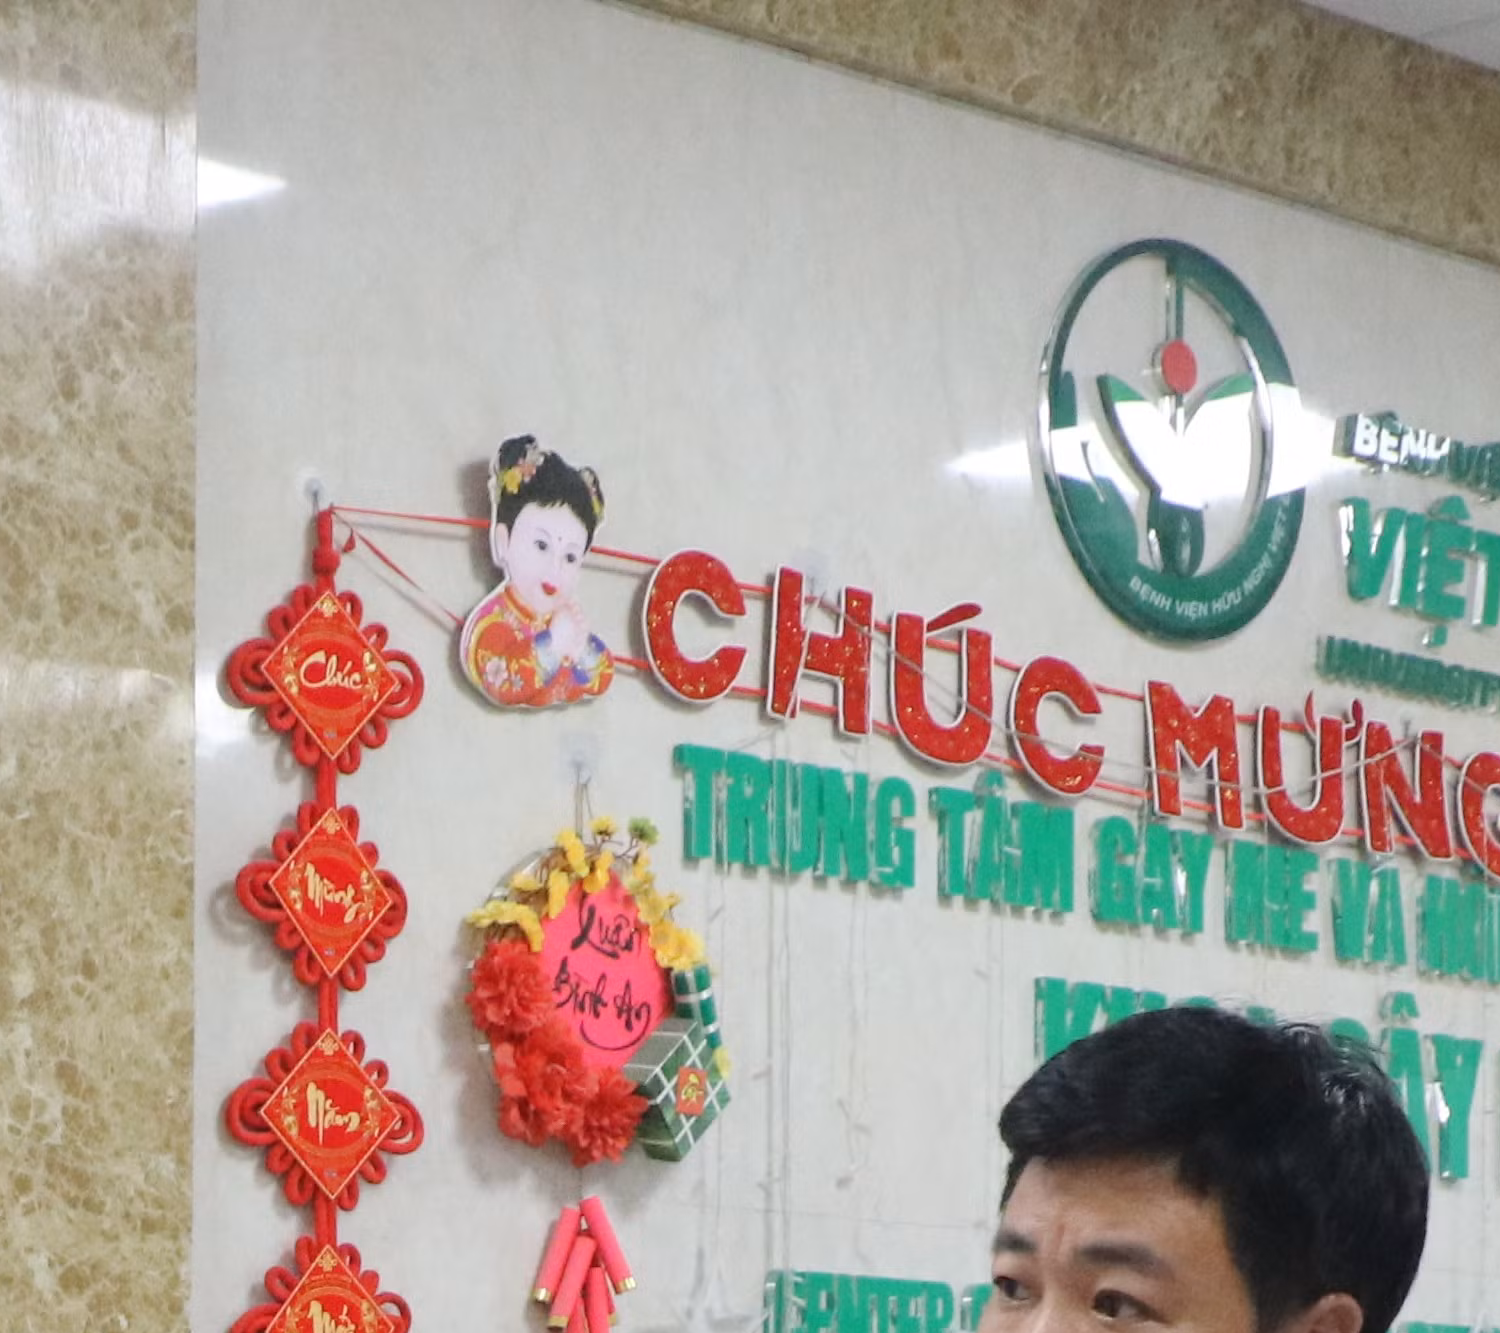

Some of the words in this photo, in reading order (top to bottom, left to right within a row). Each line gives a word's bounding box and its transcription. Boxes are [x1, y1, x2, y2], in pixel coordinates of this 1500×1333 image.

[300, 649, 363, 689] Chúc
[642, 548, 1106, 797] CHÚC
[674, 743, 915, 893] TRUNG
[928, 770, 1075, 914] TÂM
[1330, 991, 1483, 1181] ÂY
